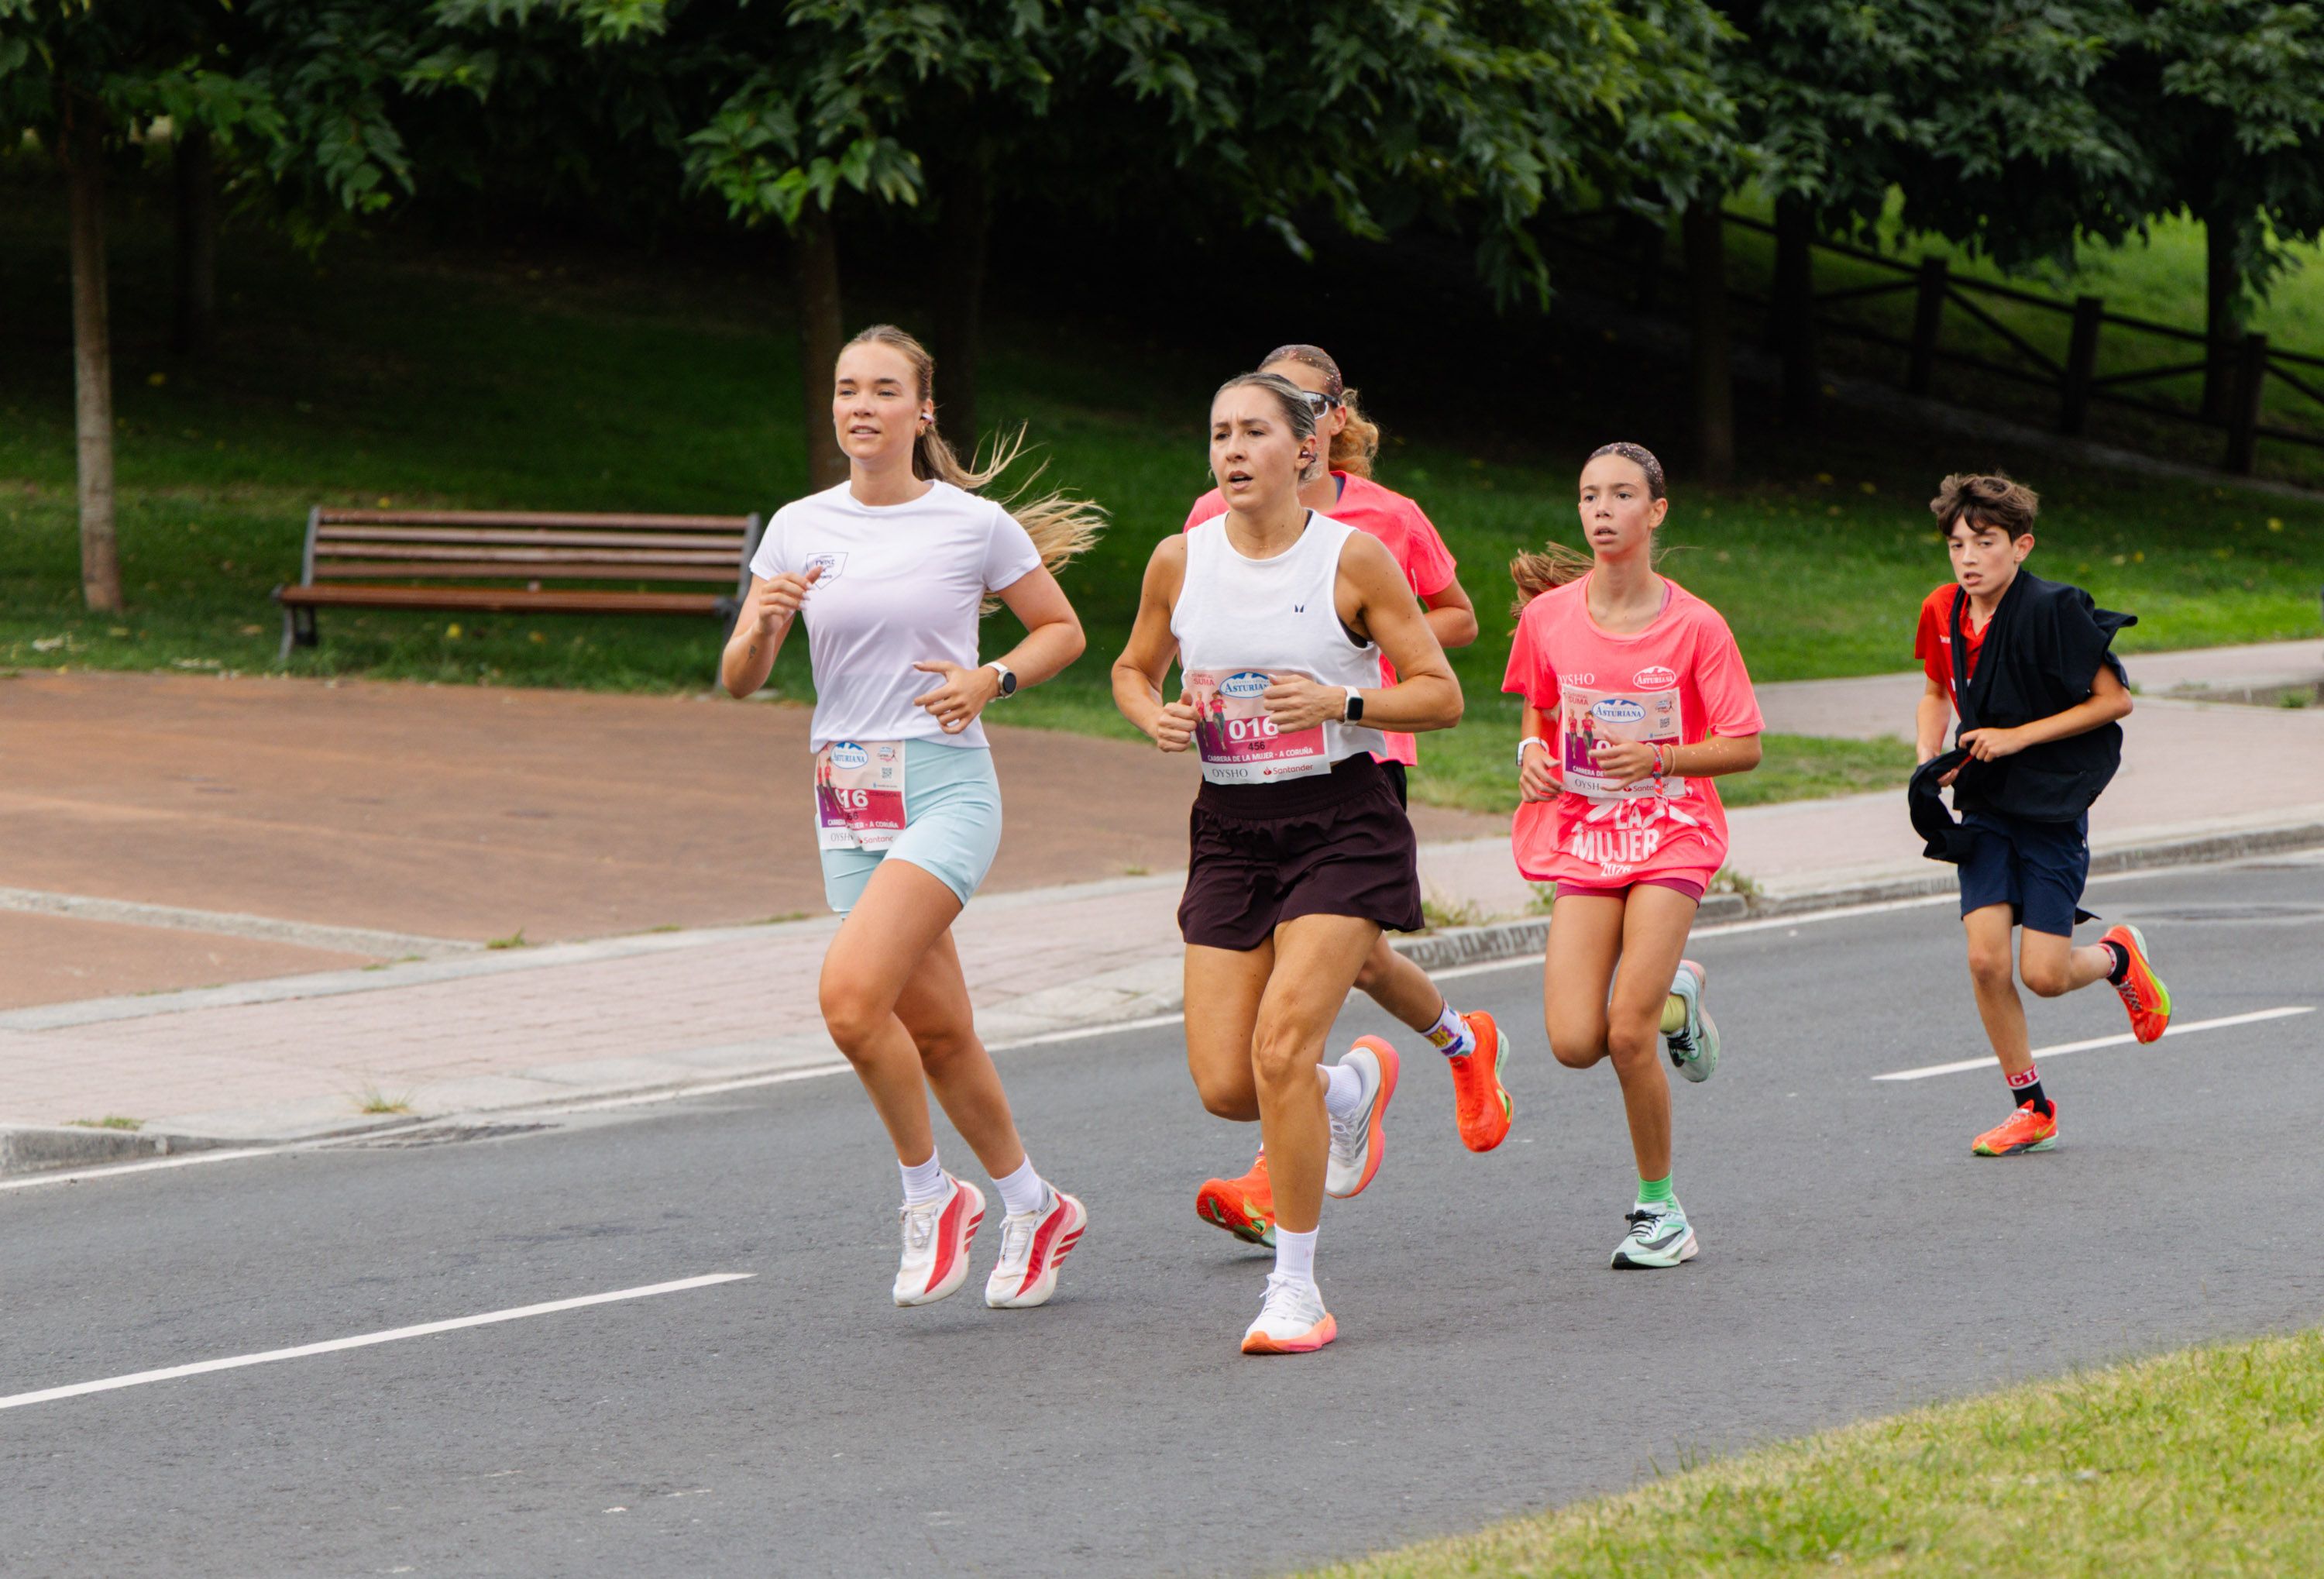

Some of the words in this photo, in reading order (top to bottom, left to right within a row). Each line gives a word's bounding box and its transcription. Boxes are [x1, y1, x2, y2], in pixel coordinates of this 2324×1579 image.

[1193, 677, 1215, 686] SUMA
[1637, 675, 1673, 684] ASTURIANA
[1225, 682, 1269, 692] ASTURIAN
[1568, 697, 1589, 706] SUMA
[1597, 706, 1641, 717] ASTURIANA
[1229, 717, 1278, 740] 016
[1248, 741, 1265, 751] 456
[1252, 752, 1274, 761] MUJER
[1285, 746, 1314, 757] CORUÑA
[1212, 768, 1248, 778] OYSHO
[1273, 764, 1314, 775] Santander
[1573, 765, 1595, 776] CARRERA
[1596, 768, 1604, 776] DE
[1615, 800, 1642, 830] LA
[1571, 828, 1660, 863] MUJER
